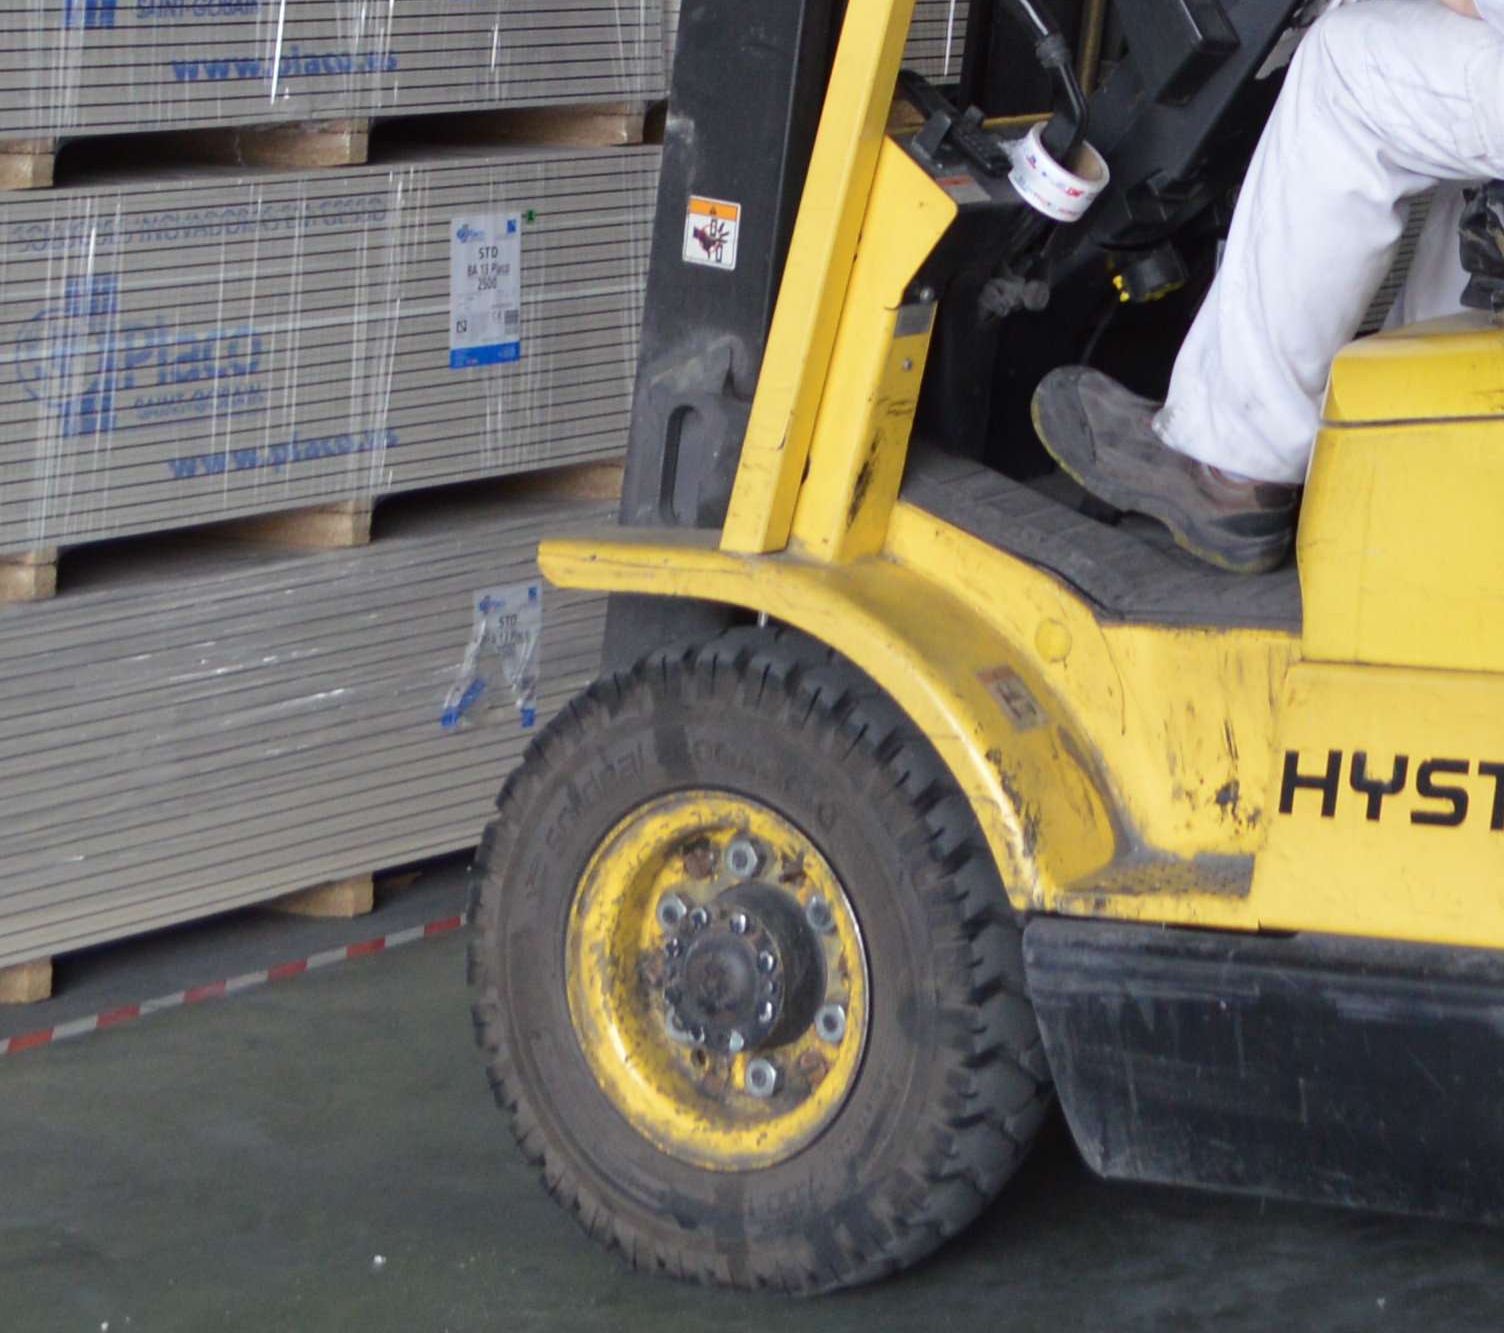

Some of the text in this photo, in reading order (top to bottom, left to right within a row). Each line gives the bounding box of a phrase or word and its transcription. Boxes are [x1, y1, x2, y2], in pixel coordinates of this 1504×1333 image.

[171, 43, 398, 84] www.placo.es
[135, 207, 275, 248] INOVADORAS
[319, 196, 388, 229] GESSO
[467, 264, 478, 278] BA
[480, 262, 489, 276] 13
[478, 246, 499, 260] STD
[123, 315, 263, 390] Placo
[169, 429, 398, 480] www.placo.es
